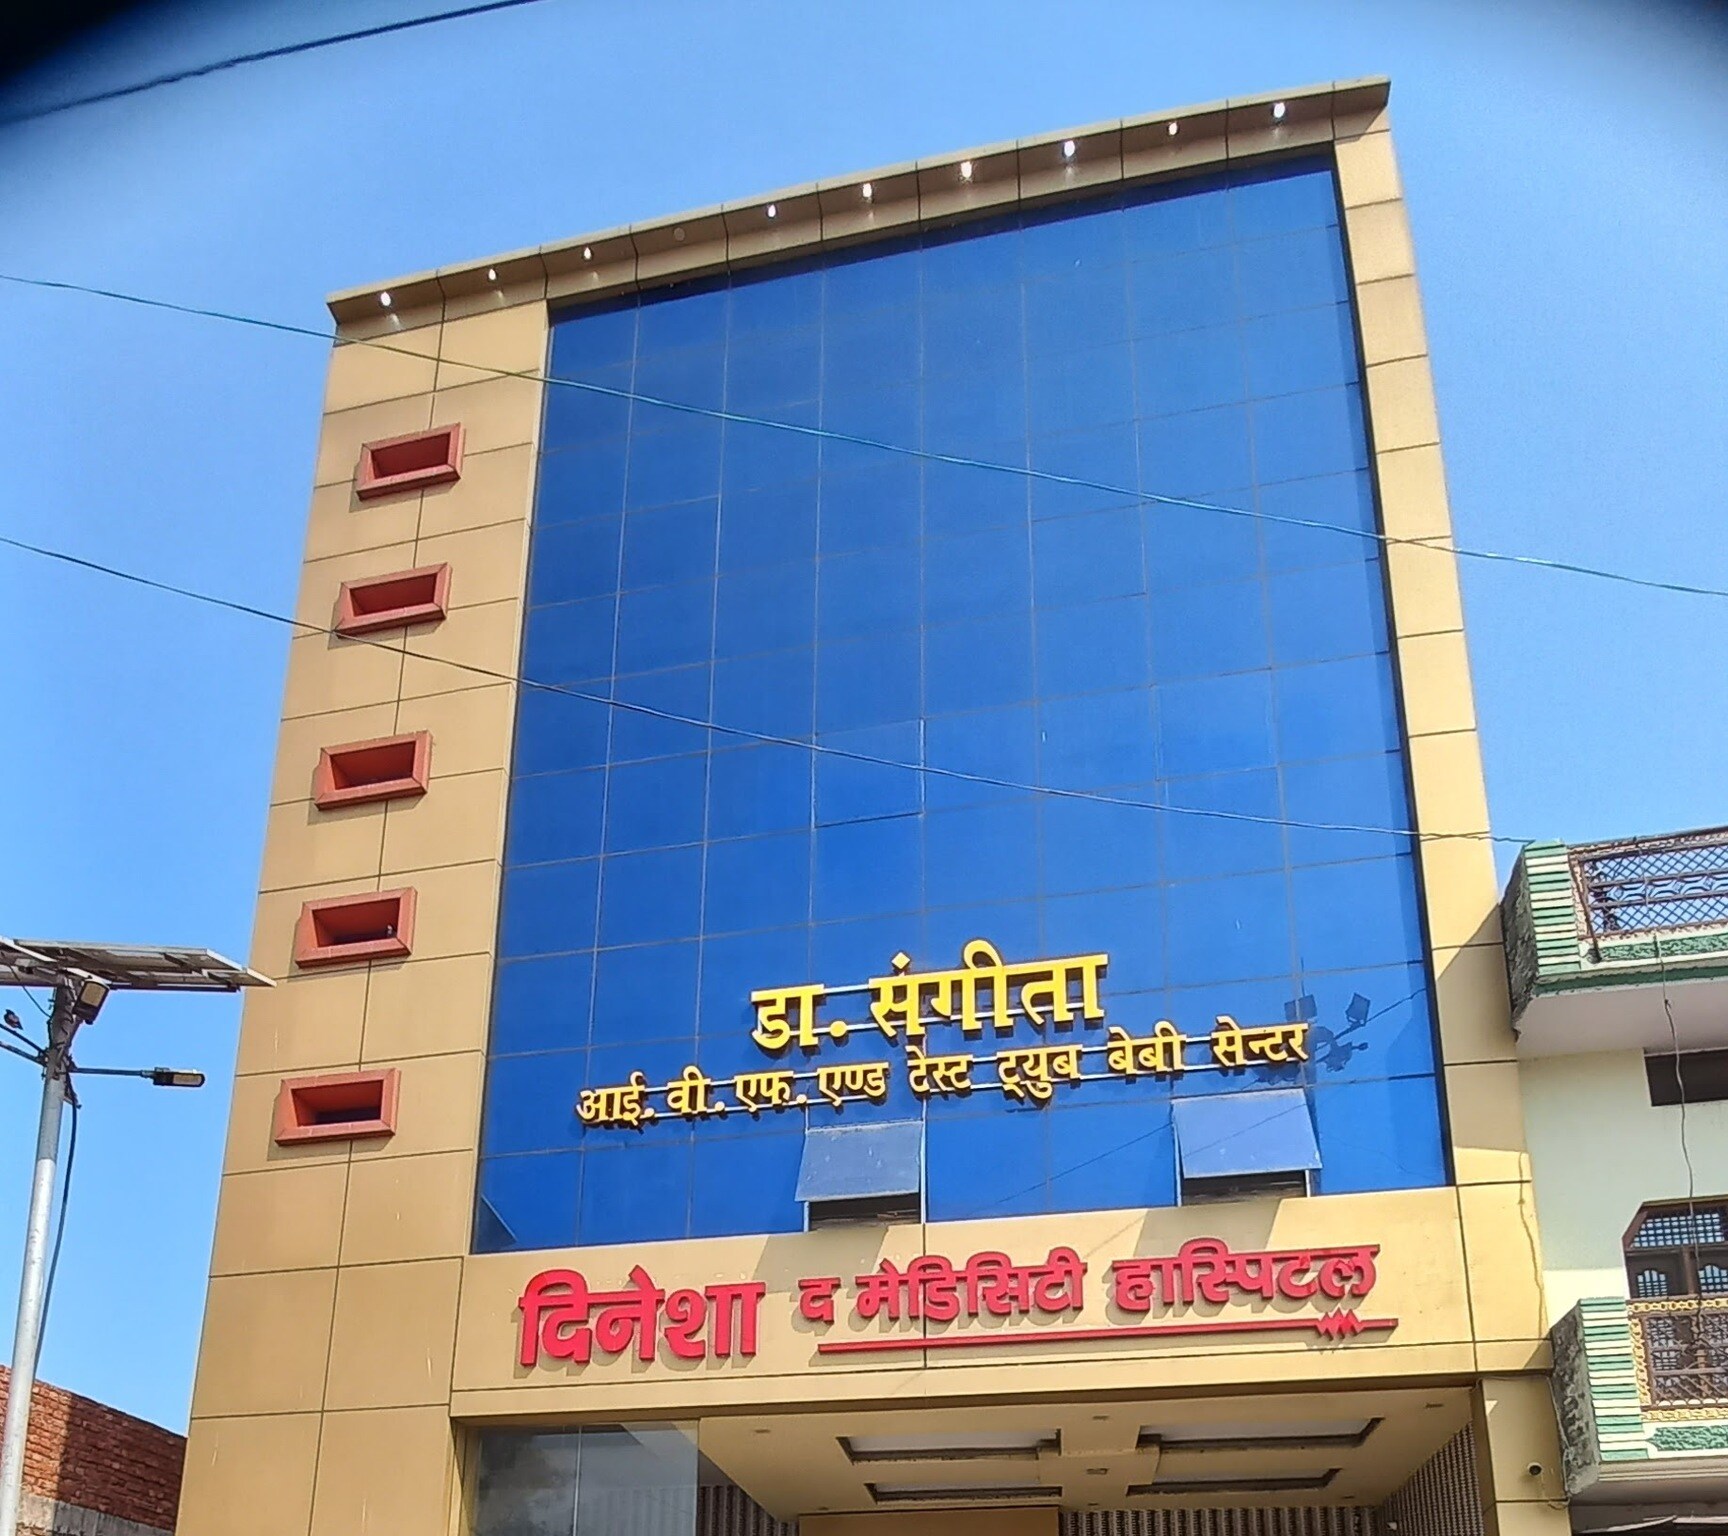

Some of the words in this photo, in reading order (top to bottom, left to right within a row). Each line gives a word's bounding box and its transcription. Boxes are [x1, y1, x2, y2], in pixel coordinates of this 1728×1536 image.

[751, 983, 848, 1050] डा.
[868, 939, 1109, 1038] संगीता
[576, 1071, 655, 1127] आई.
[666, 1065, 726, 1114] वी.
[733, 1070, 808, 1113] एफ.
[816, 1062, 890, 1108] एण्ड
[906, 1045, 974, 1093] टेस्ट
[1107, 1020, 1188, 1075] बेबी
[1211, 1016, 1310, 1068] सेन्टर
[518, 1264, 767, 1368] दिनेशा
[798, 1277, 841, 1322] द
[855, 1246, 1088, 1321] मेडिसिटी
[1112, 1237, 1381, 1312] हास्पिटल
